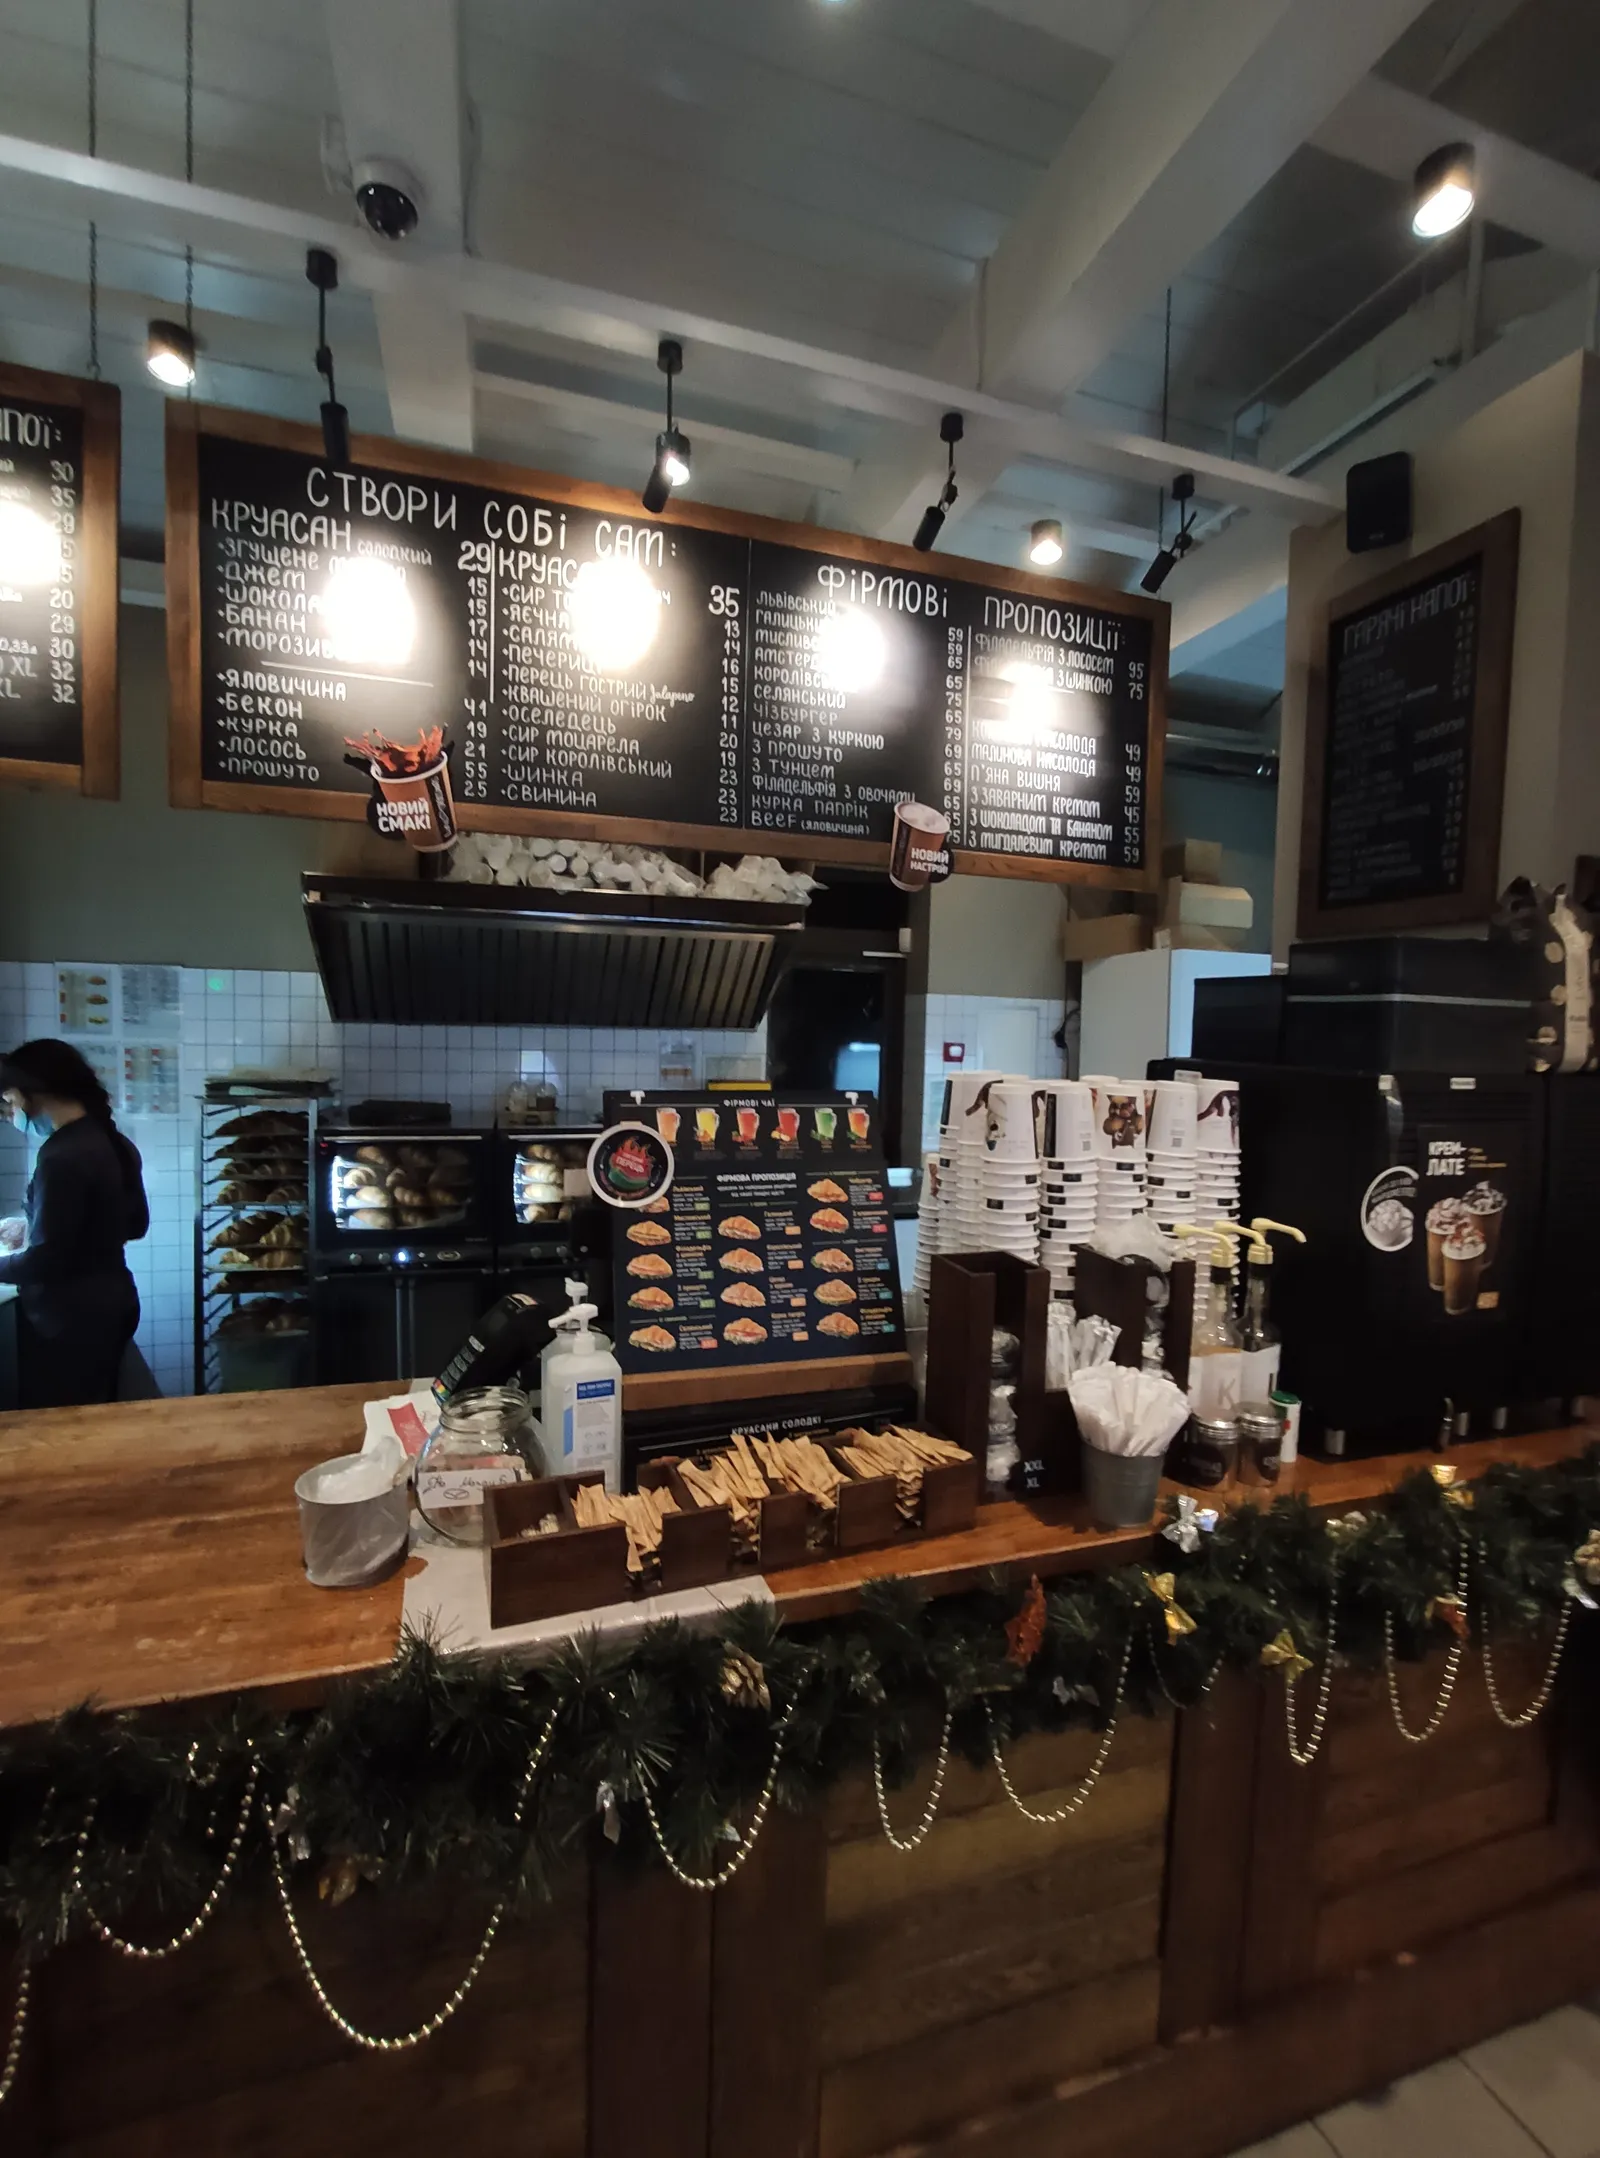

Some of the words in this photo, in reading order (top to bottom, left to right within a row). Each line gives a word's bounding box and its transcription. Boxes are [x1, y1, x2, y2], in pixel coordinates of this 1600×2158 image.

[50, 460, 75, 483] 30
[50, 484, 76, 508] 35
[307, 467, 456, 530] СТВОРИ
[484, 500, 566, 550] СОБІ
[212, 498, 351, 550] КРУАСАН
[457, 540, 492, 574] 29
[49, 587, 74, 609] 20
[225, 561, 306, 591] ДЖЕМ
[468, 597, 488, 617] 15
[225, 583, 328, 616] ШОКОЛА
[468, 576, 488, 597] 15
[499, 547, 586, 588] КРУАС
[708, 585, 740, 618] 35
[817, 564, 949, 618] ФІРМОВІ
[509, 583, 545, 606] СИР
[724, 620, 740, 639] 13
[49, 636, 75, 659] 30
[225, 603, 306, 634] БАНАН
[468, 638, 488, 658] 14
[948, 627, 964, 642] 59
[225, 627, 338, 660] МОРОЗИВ
[468, 660, 488, 679] 14
[509, 625, 580, 652] САЛЯМ
[722, 658, 740, 675] 16
[724, 640, 740, 657] 14
[947, 642, 963, 656] 59
[947, 656, 963, 670] 65
[1066, 651, 1114, 675] ЛОСОСЕМ
[1128, 662, 1144, 680] 95
[50, 660, 76, 682] 32
[507, 663, 573, 690] ПЕРЕЦЬ
[580, 674, 646, 701] ГОСТРИЙ
[721, 695, 739, 713] 12
[721, 677, 739, 693] 15
[946, 675, 963, 690] 65
[1066, 672, 1113, 695] ШИНКОЮ
[1129, 683, 1144, 700] 75
[52, 682, 76, 704] 32
[224, 668, 347, 701] ЯЛОВИЧИНА
[464, 698, 488, 718] 41
[508, 687, 602, 714] КВАШЕНИЙ
[610, 699, 667, 722] ОГІРОК
[721, 713, 737, 730] 11
[946, 692, 963, 707] 75
[224, 692, 304, 720] БЕКОН
[466, 720, 488, 739] 19
[508, 707, 617, 736] ОСЕЛЕДЕЦЬ
[719, 732, 738, 749] 20
[753, 702, 839, 727] ЧІЗБУРГЕР
[945, 726, 962, 741] 79
[945, 709, 962, 724] 65
[225, 716, 299, 739] КУРКА
[464, 743, 488, 762] 21
[508, 727, 540, 744] СИР
[546, 728, 640, 756] МОЦАРЕЛА
[720, 751, 736, 768] 19
[752, 721, 801, 740] ЦЕЗАР
[828, 730, 884, 751] КУРКОЮ
[944, 743, 961, 759] 69
[1125, 743, 1141, 762] 49
[227, 736, 307, 761] ЛОСОСЬ
[464, 762, 488, 781] 55
[508, 746, 540, 764] СИР
[546, 748, 672, 779] КОРОЛІВСЬКИЙ
[719, 768, 738, 786] 23
[768, 741, 843, 764] ПРОШУТО
[944, 760, 961, 776] 65
[769, 758, 835, 780] ТУНЦЕМ
[944, 777, 961, 793] 69
[1036, 754, 1096, 778] НАСОЛОДА
[1125, 765, 1141, 783] 49
[228, 757, 320, 782] ПРОШУТО
[464, 780, 488, 798] 25
[507, 766, 584, 788] ШИНКА
[718, 787, 738, 805] 23
[752, 773, 836, 799] ФІЛАДЕЛЬФІЯ
[943, 796, 960, 811] 65
[1017, 772, 1061, 793] ВИШНЯ
[1125, 786, 1140, 803] 59
[376, 797, 430, 818] НОВИЙ
[506, 783, 597, 807] СВИНИНА
[719, 806, 738, 824] 23
[752, 793, 803, 814] КУРКА
[814, 801, 869, 820] ПАПРІК
[981, 787, 1046, 812] ЗАВАРНИМ
[1052, 796, 1100, 819] КРЕМОМ
[1124, 806, 1140, 824] 45
[980, 809, 1046, 834] ШОКОЛАДОМ
[1049, 816, 1062, 835] ТА
[1066, 819, 1113, 841] БАНАНОМ
[1124, 826, 1140, 844] 55
[911, 847, 949, 865] НОВИЙ
[980, 831, 1053, 853] МИГДАЛЕВИМ
[1060, 840, 1107, 861] КРЕМОМ
[1124, 847, 1140, 864] 59
[723, 1098, 759, 1108] ФІРМОВІ
[716, 1173, 751, 1184] ФІРМОВА
[1426, 1158, 1466, 1176] ЛАТЕ
